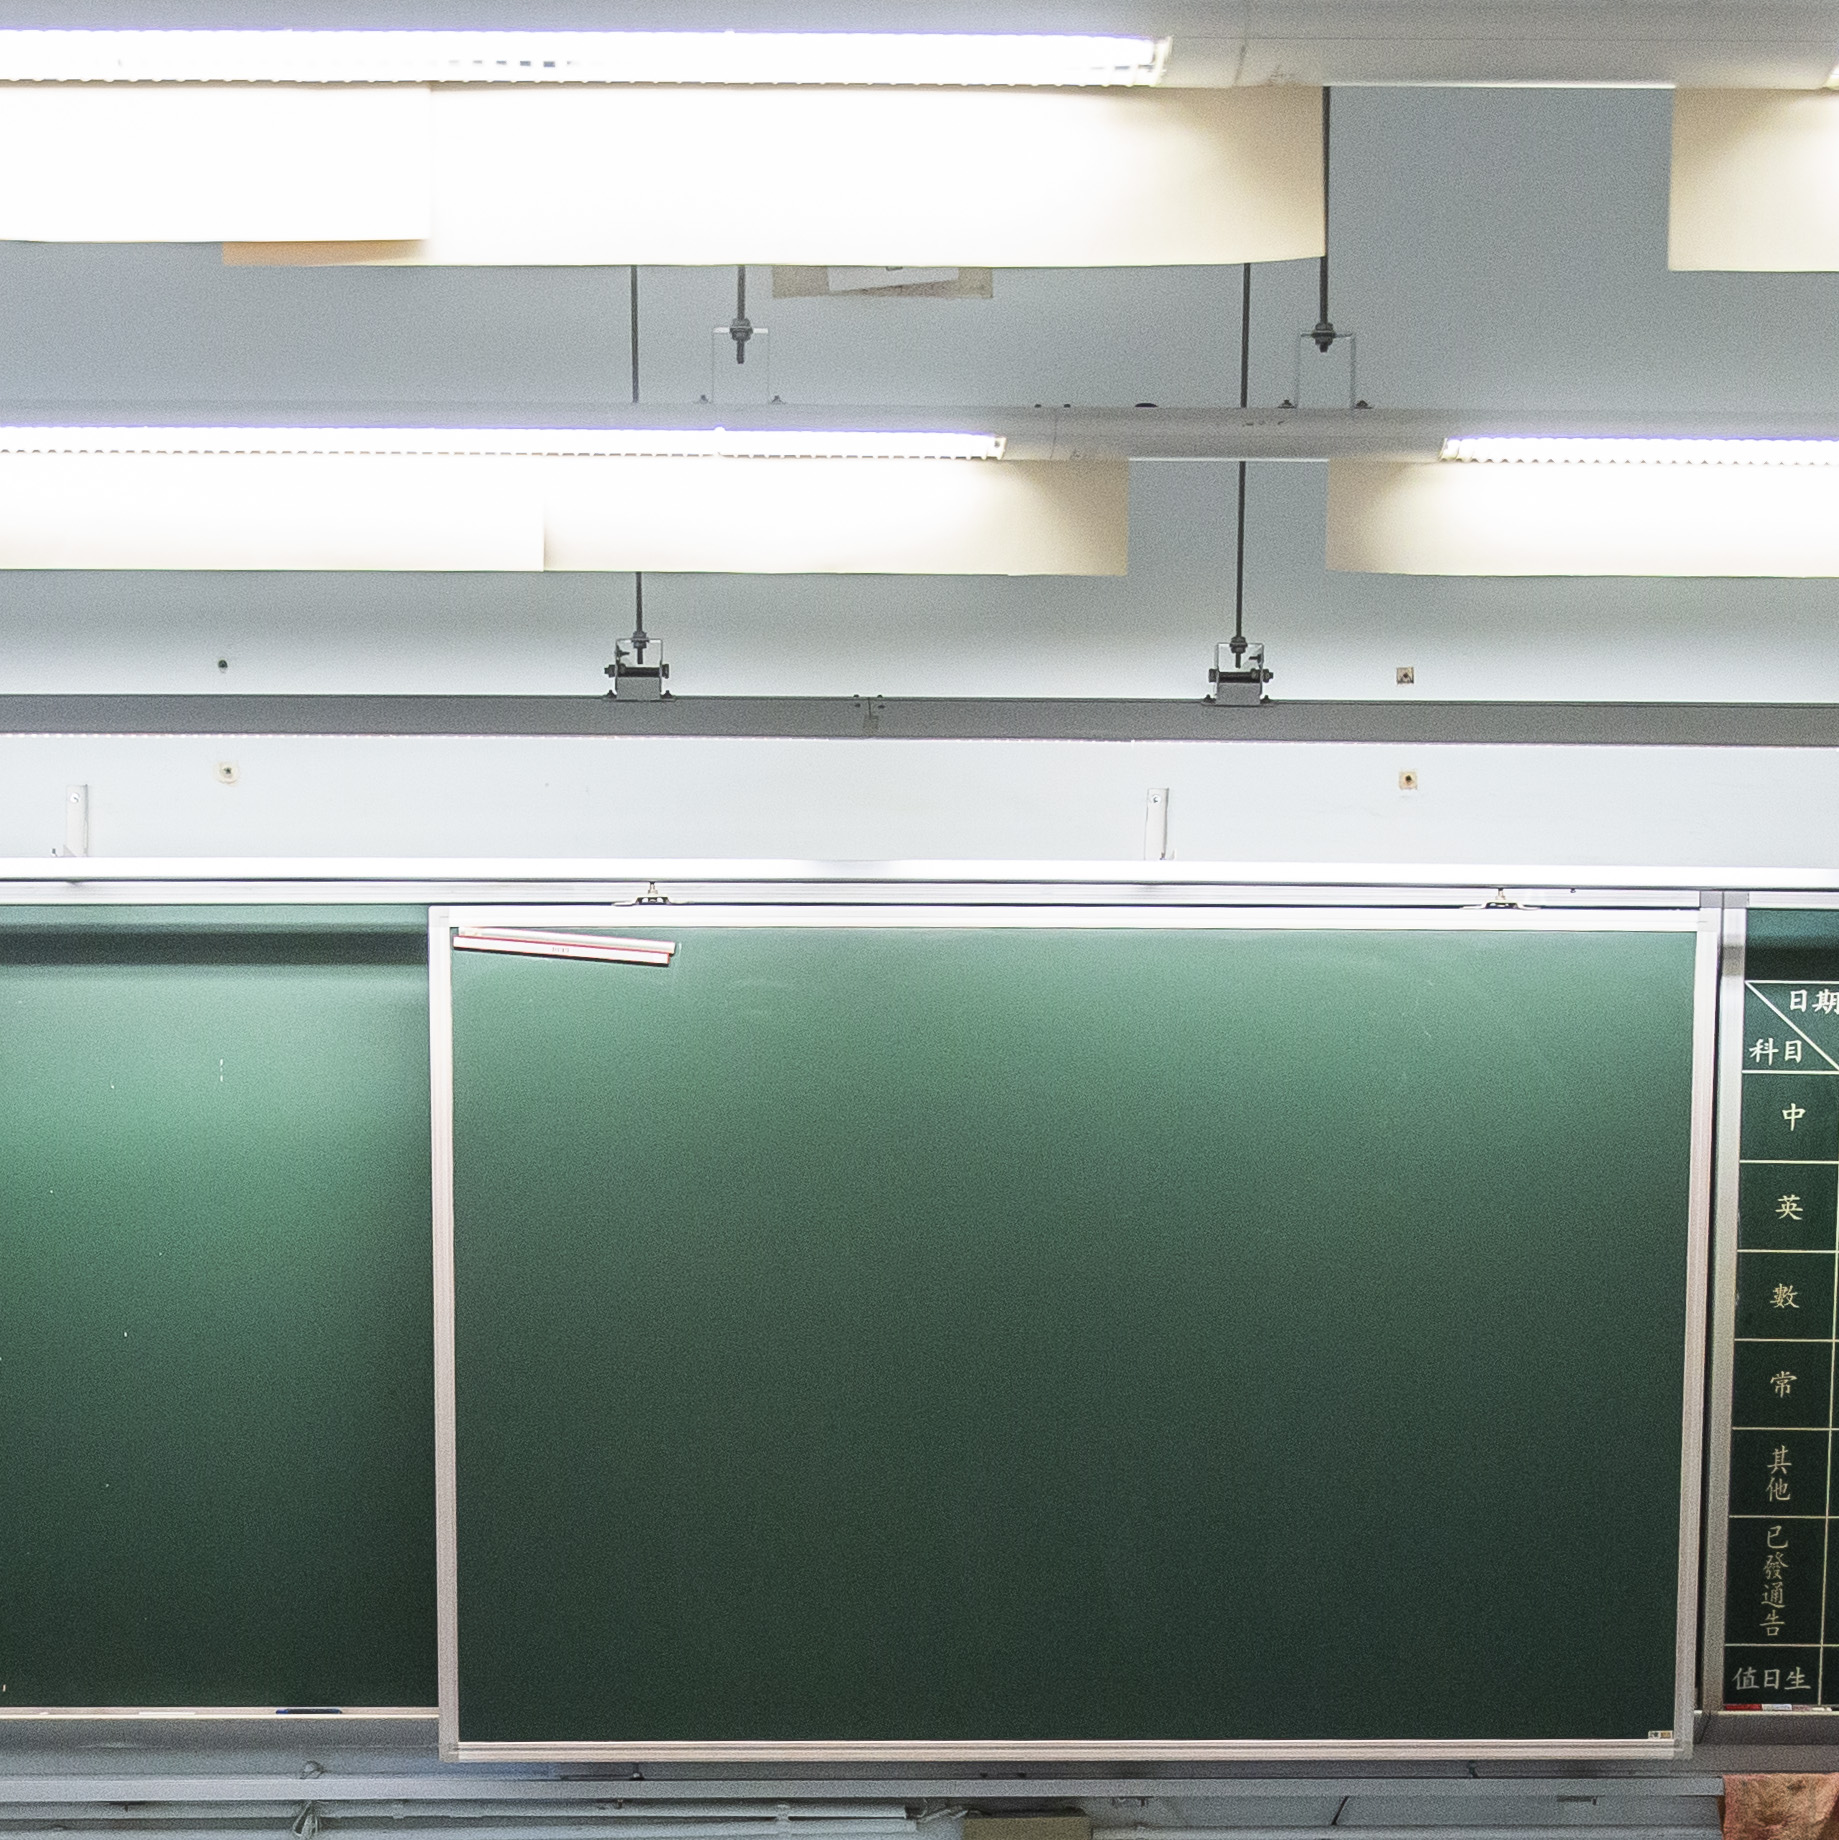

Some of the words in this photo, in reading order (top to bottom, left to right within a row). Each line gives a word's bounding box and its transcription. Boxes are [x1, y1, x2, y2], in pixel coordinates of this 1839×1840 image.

[1749, 1037, 1802, 1065] 科目
[1782, 1103, 1806, 1131] 中
[1775, 1194, 1803, 1220] 英
[1770, 1283, 1800, 1309] 數
[1770, 1370, 1797, 1398] 常
[1765, 1444, 1792, 1502] 其他
[1760, 1525, 1789, 1636] 已發通告
[1731, 1665, 1811, 1690] 值日生
